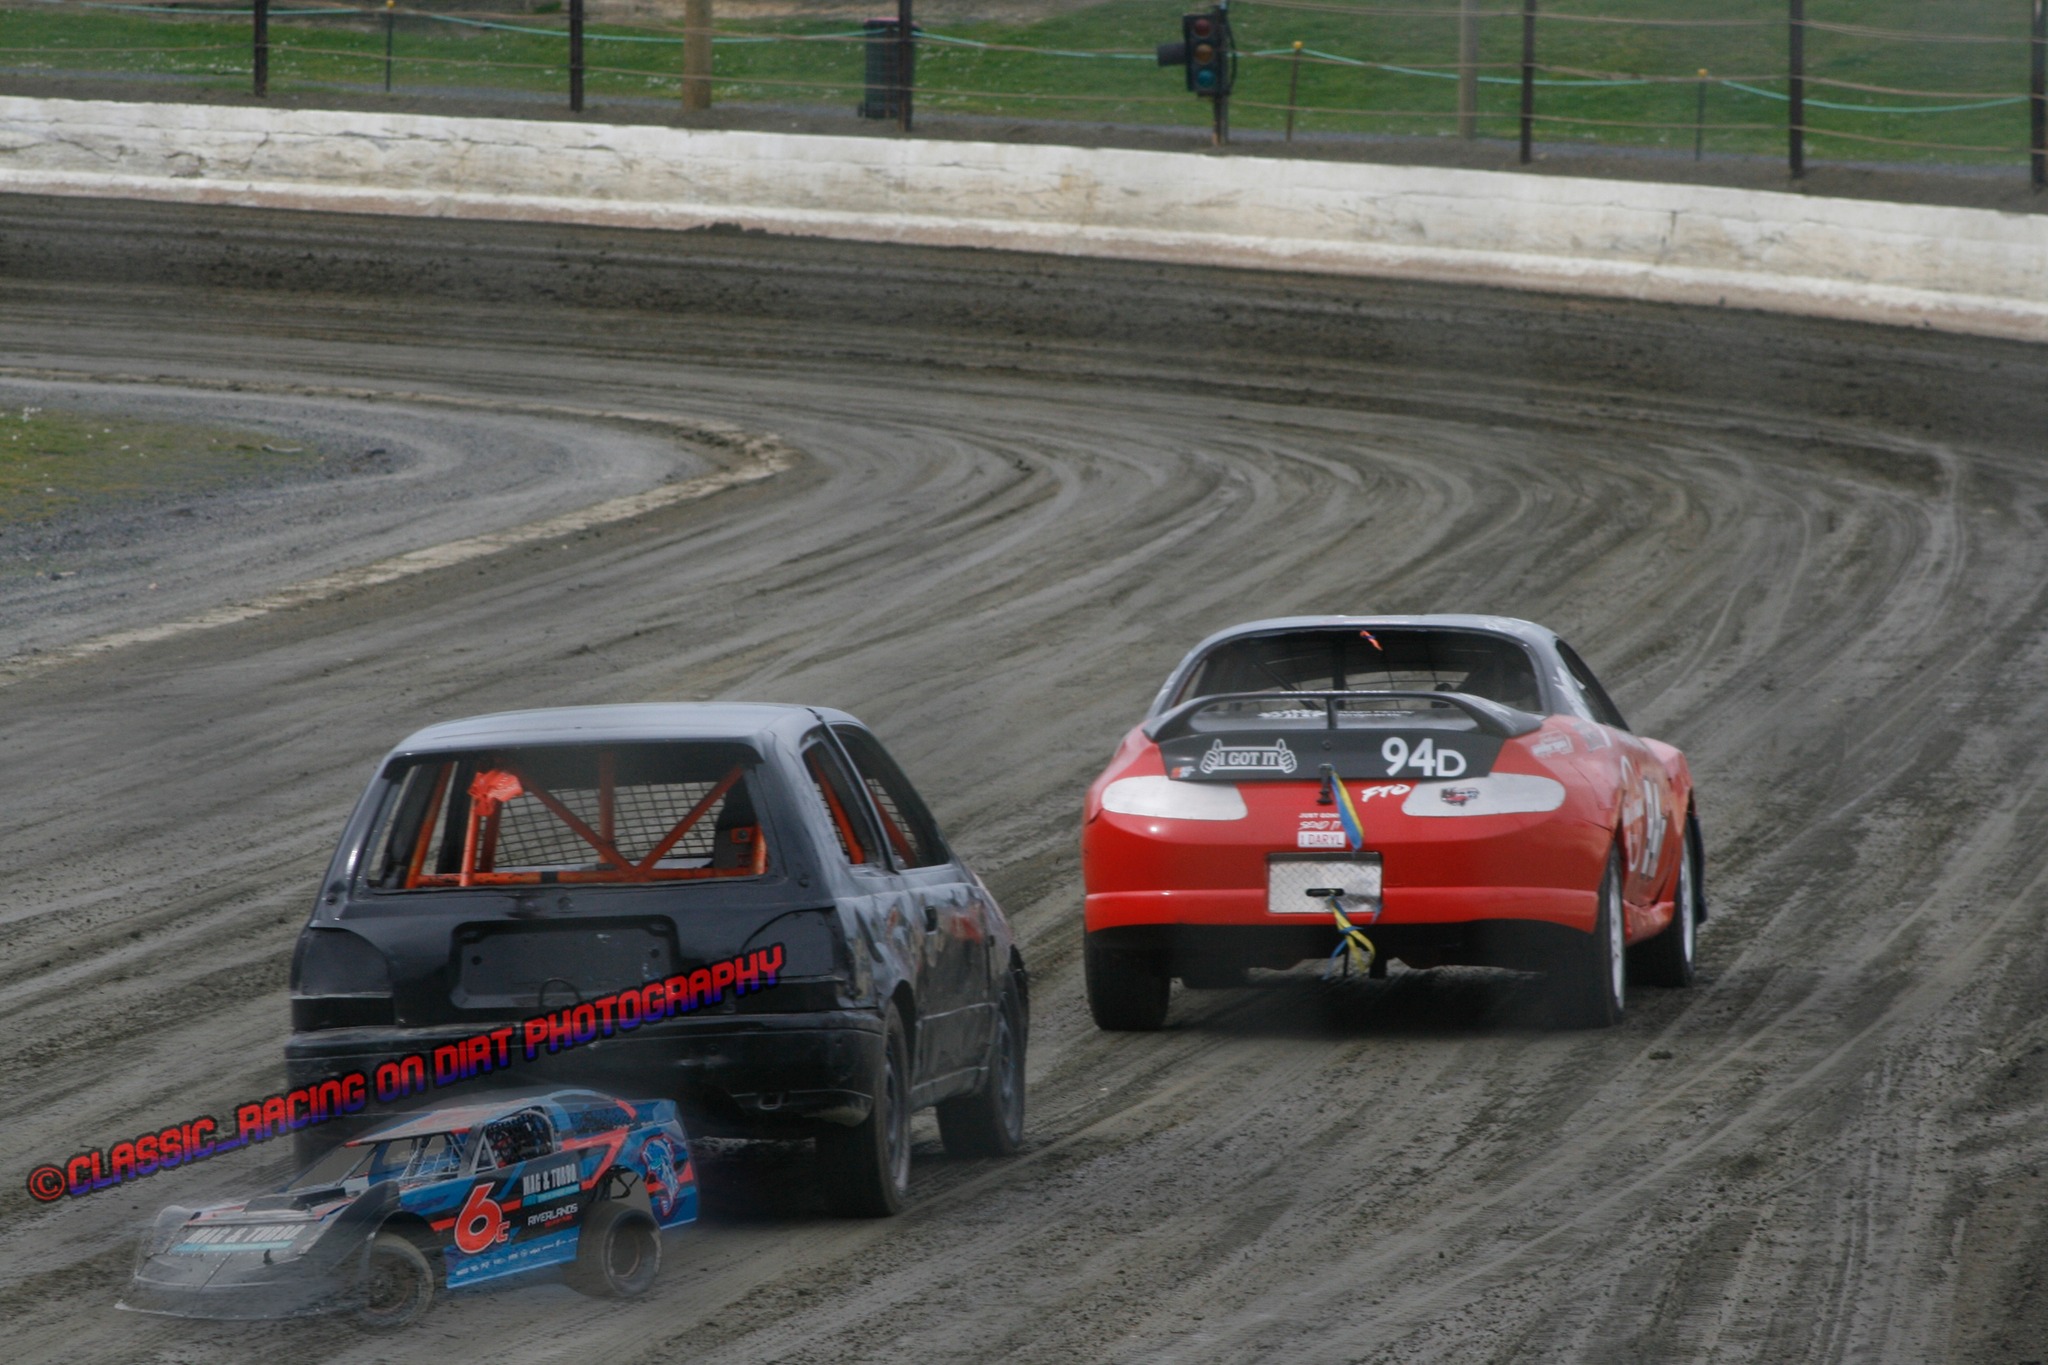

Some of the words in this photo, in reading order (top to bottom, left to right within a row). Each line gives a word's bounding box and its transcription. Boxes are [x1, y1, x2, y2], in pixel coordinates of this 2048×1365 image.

[1219, 752, 1226, 766] I
[1228, 752, 1260, 766] GOT
[1262, 752, 1278, 766] IT
[1382, 737, 1467, 777] 94D
[1308, 834, 1344, 845] DARYL
